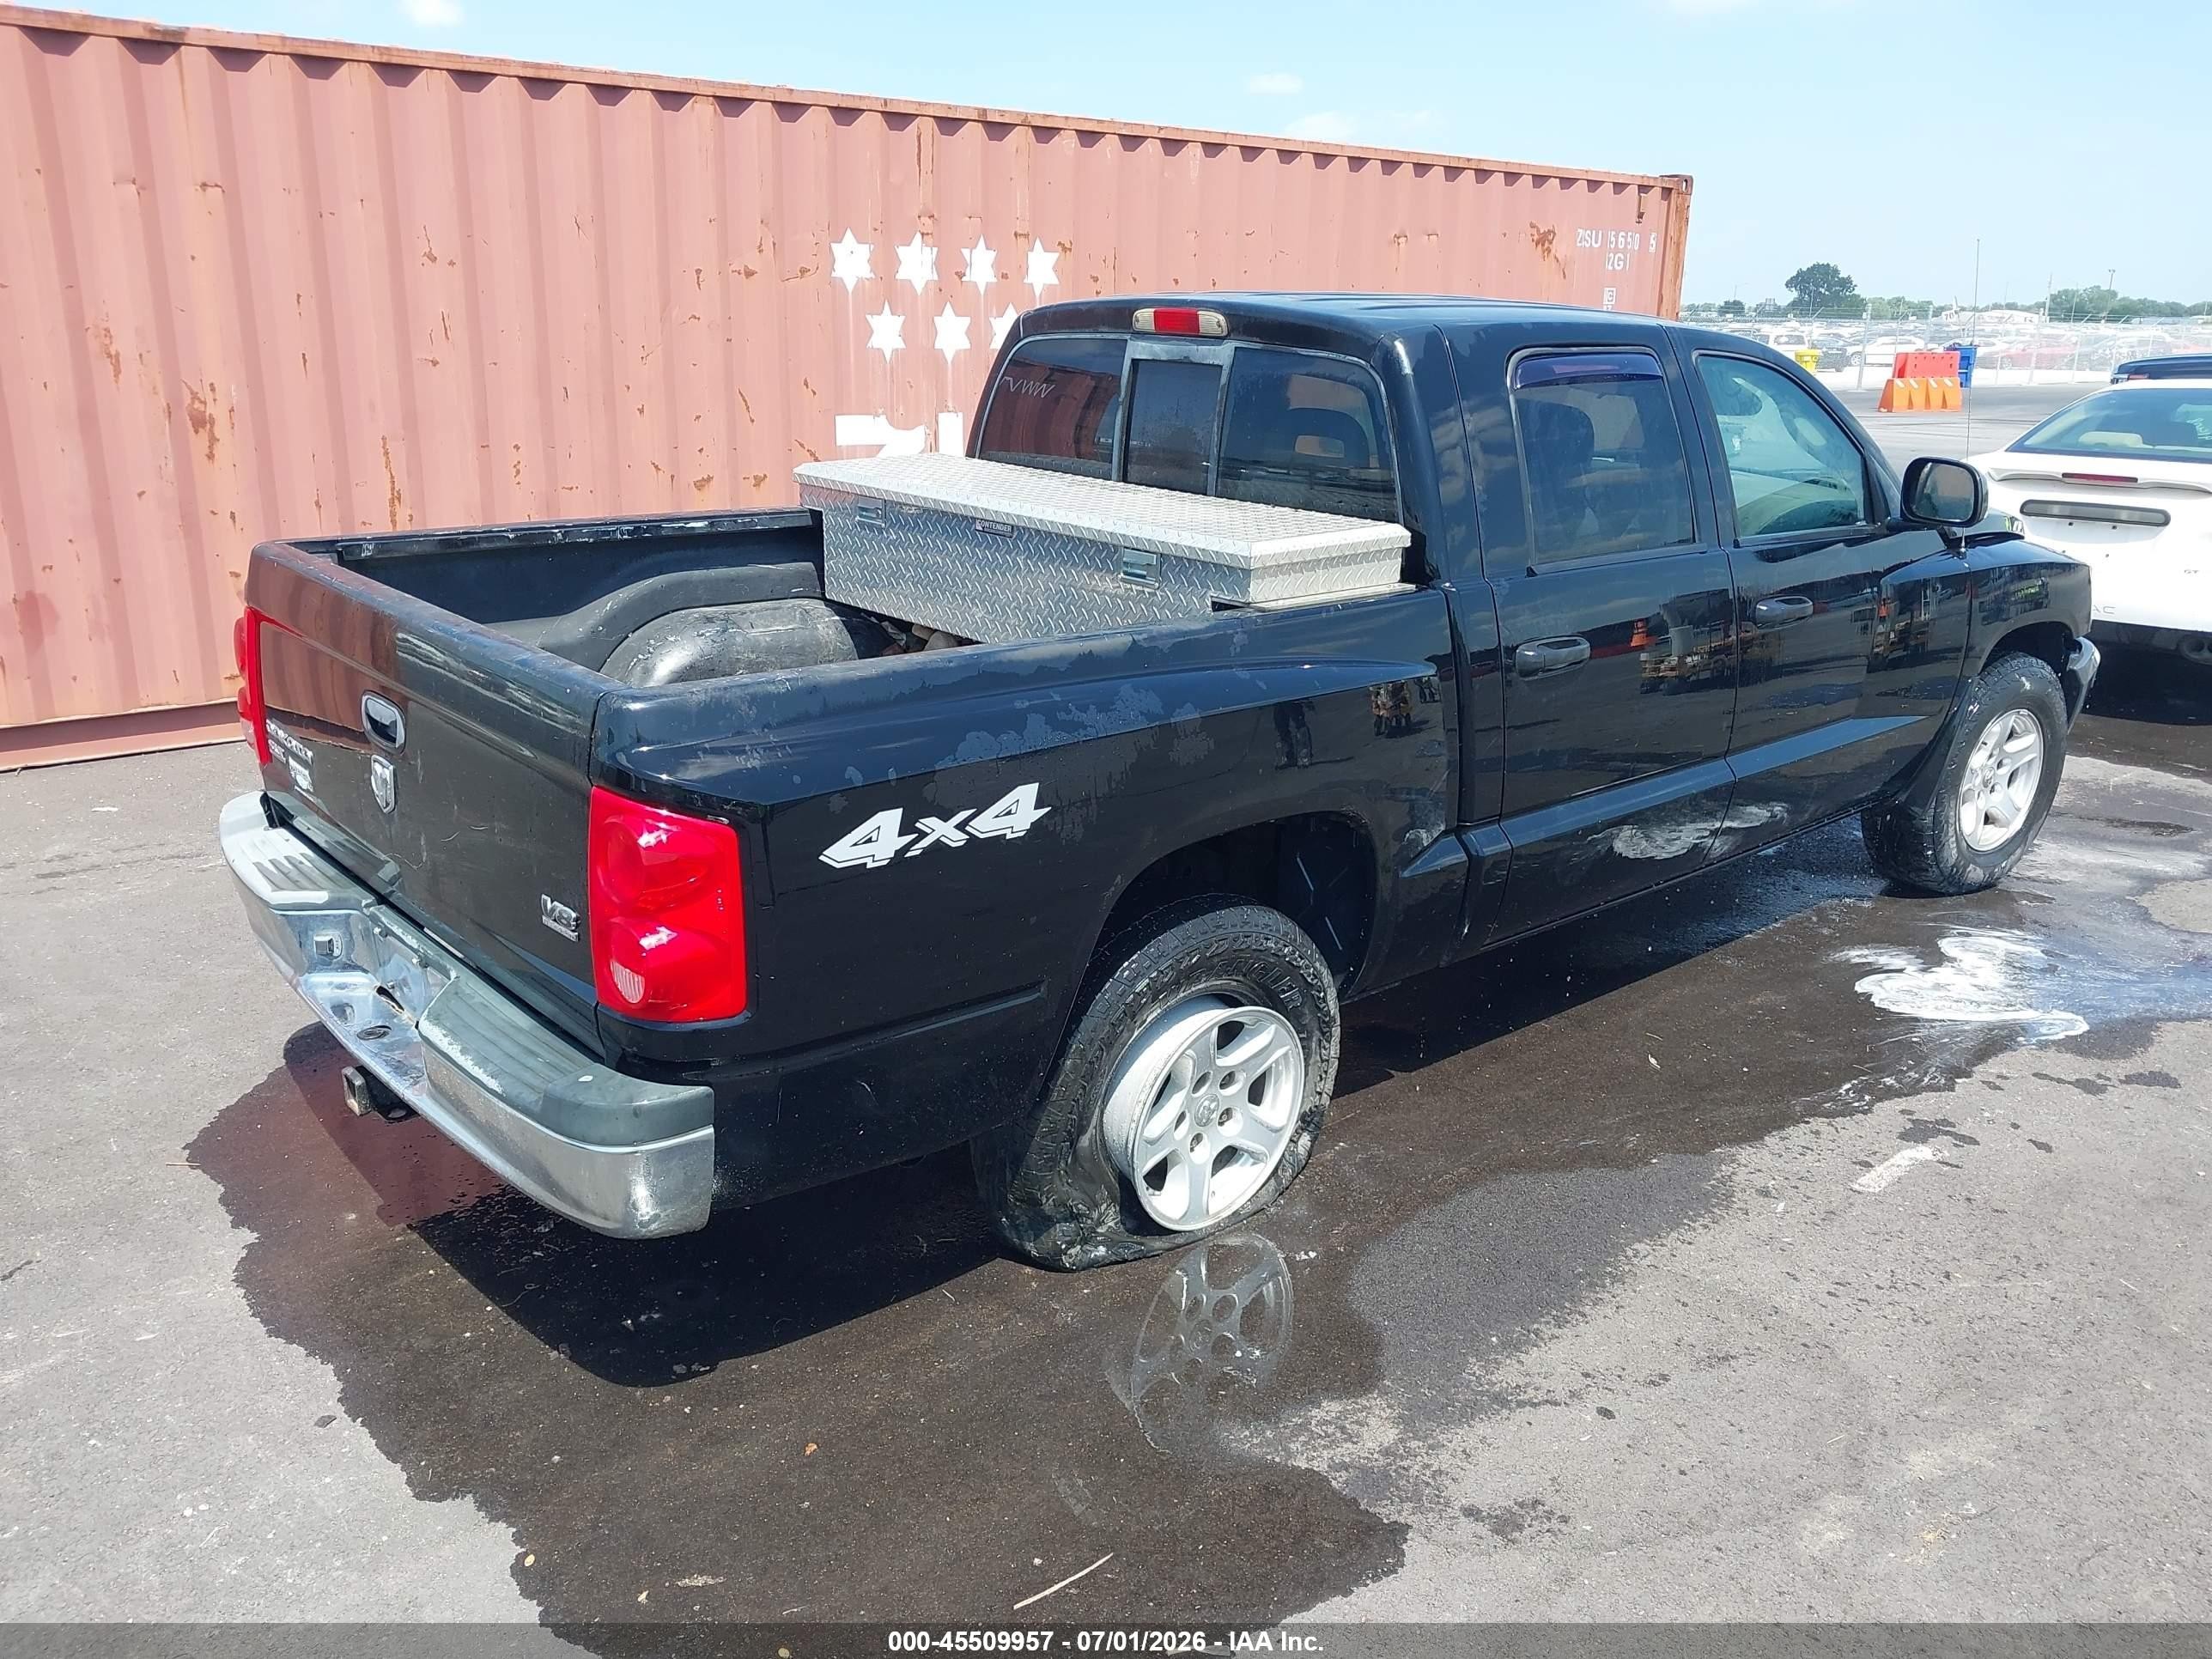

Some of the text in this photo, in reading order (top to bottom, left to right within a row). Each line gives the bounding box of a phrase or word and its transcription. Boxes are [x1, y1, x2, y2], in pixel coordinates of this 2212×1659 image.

[977, 519, 1012, 532] CONTENDER
[817, 782, 1052, 869] 4x4
[541, 894, 577, 931] V8
